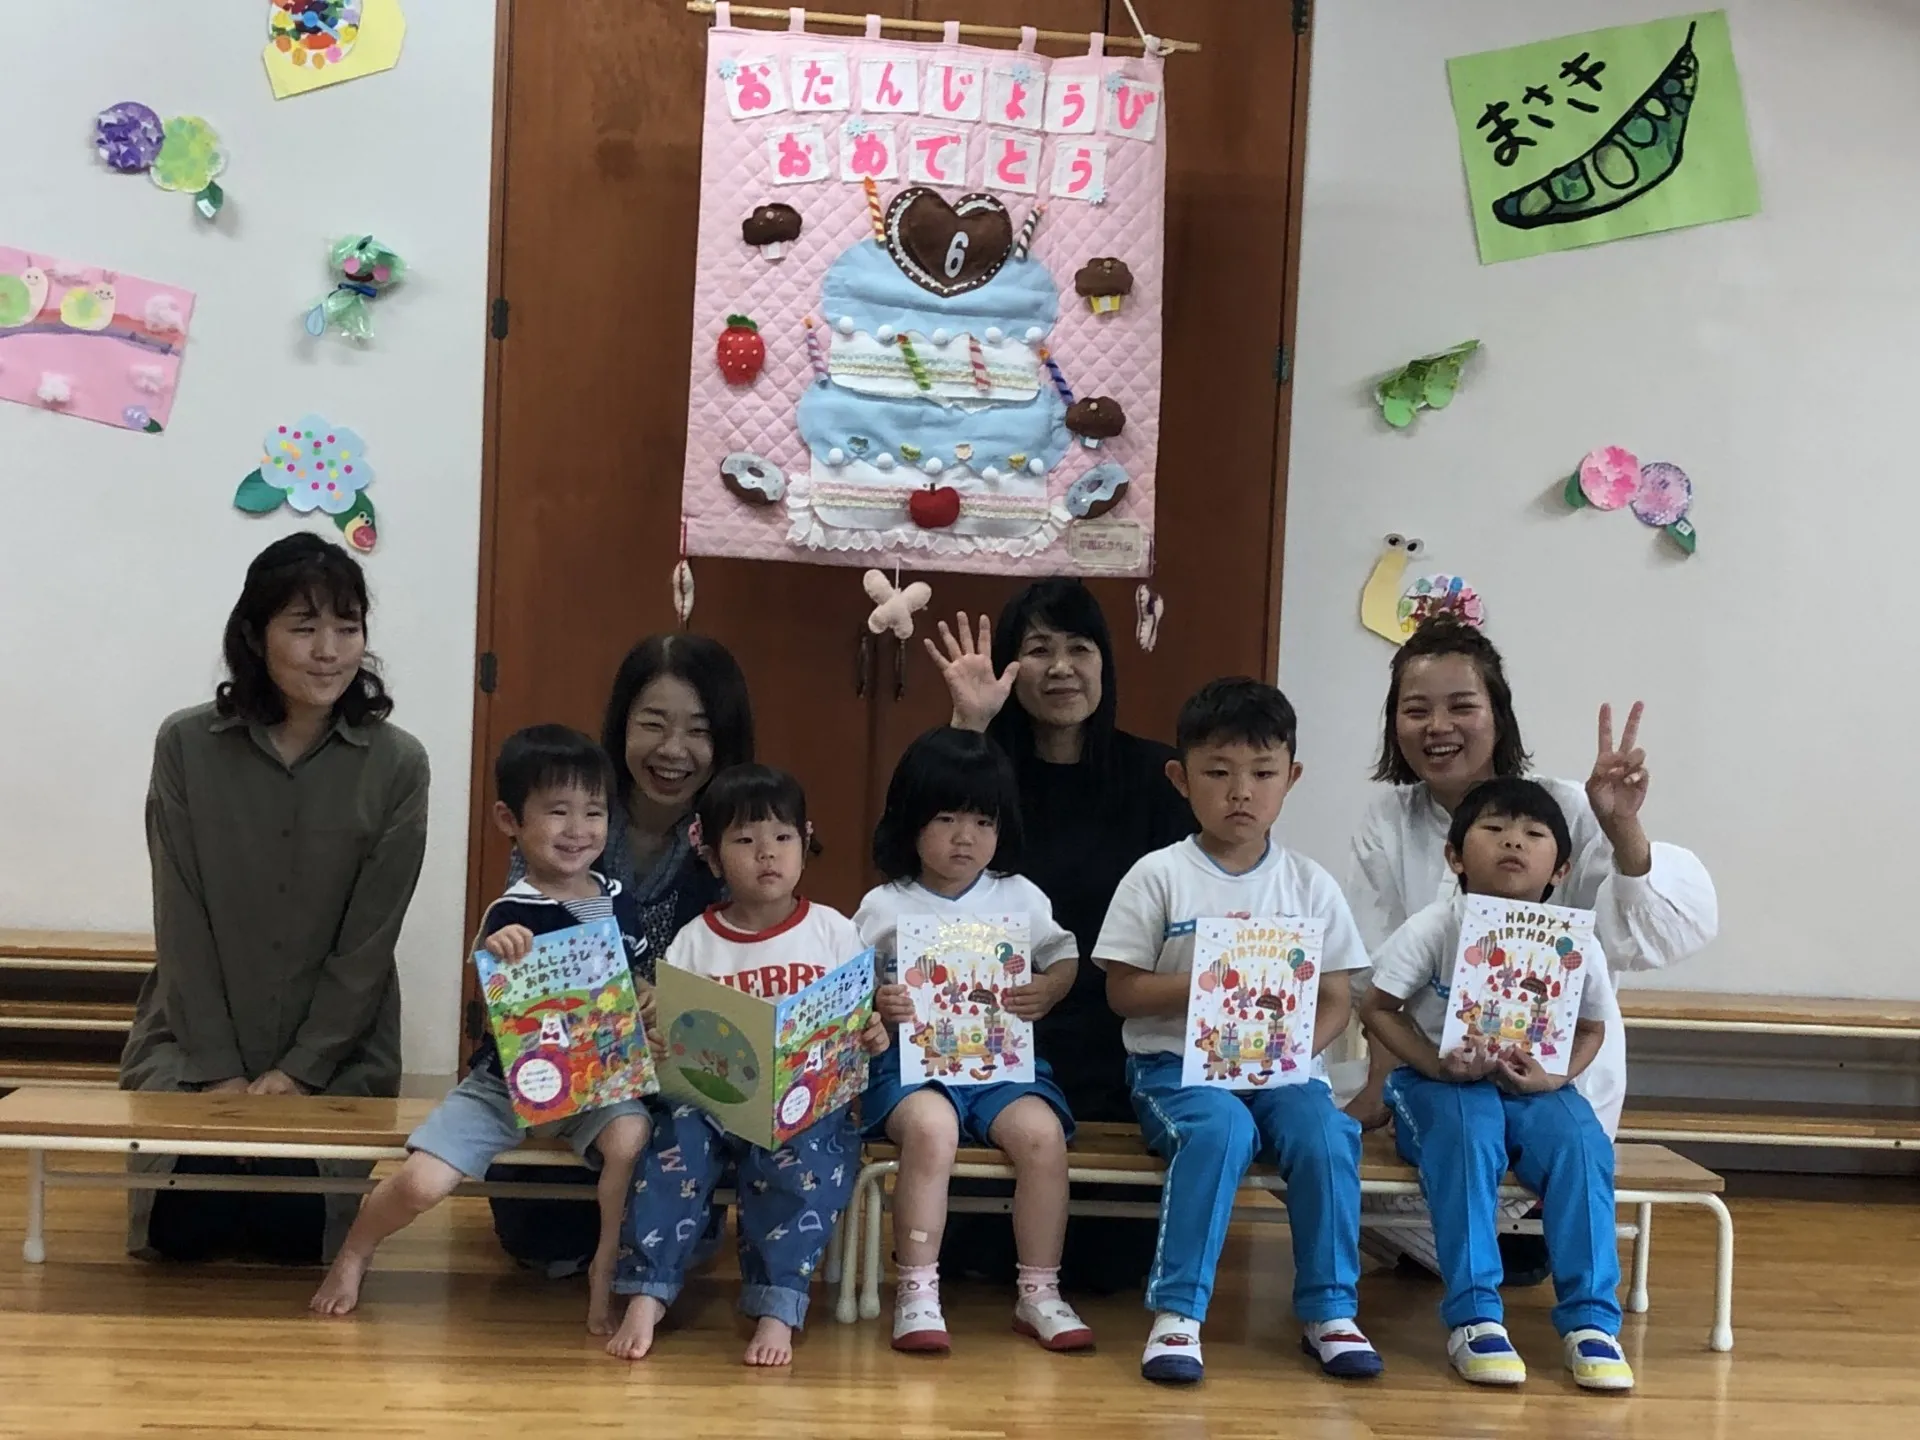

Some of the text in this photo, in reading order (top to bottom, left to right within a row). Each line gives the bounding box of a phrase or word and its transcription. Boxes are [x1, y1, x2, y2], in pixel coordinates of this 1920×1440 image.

[736, 61, 1155, 131] おたんじょうび
[1476, 52, 1607, 167] まさき
[778, 133, 1093, 194] おめでとう
[943, 231, 970, 279] 6
[1236, 928, 1286, 943] HAPPY
[1506, 911, 1556, 930] HAPPY
[510, 949, 591, 981] おたんじょうび
[525, 963, 582, 989] おめでとう
